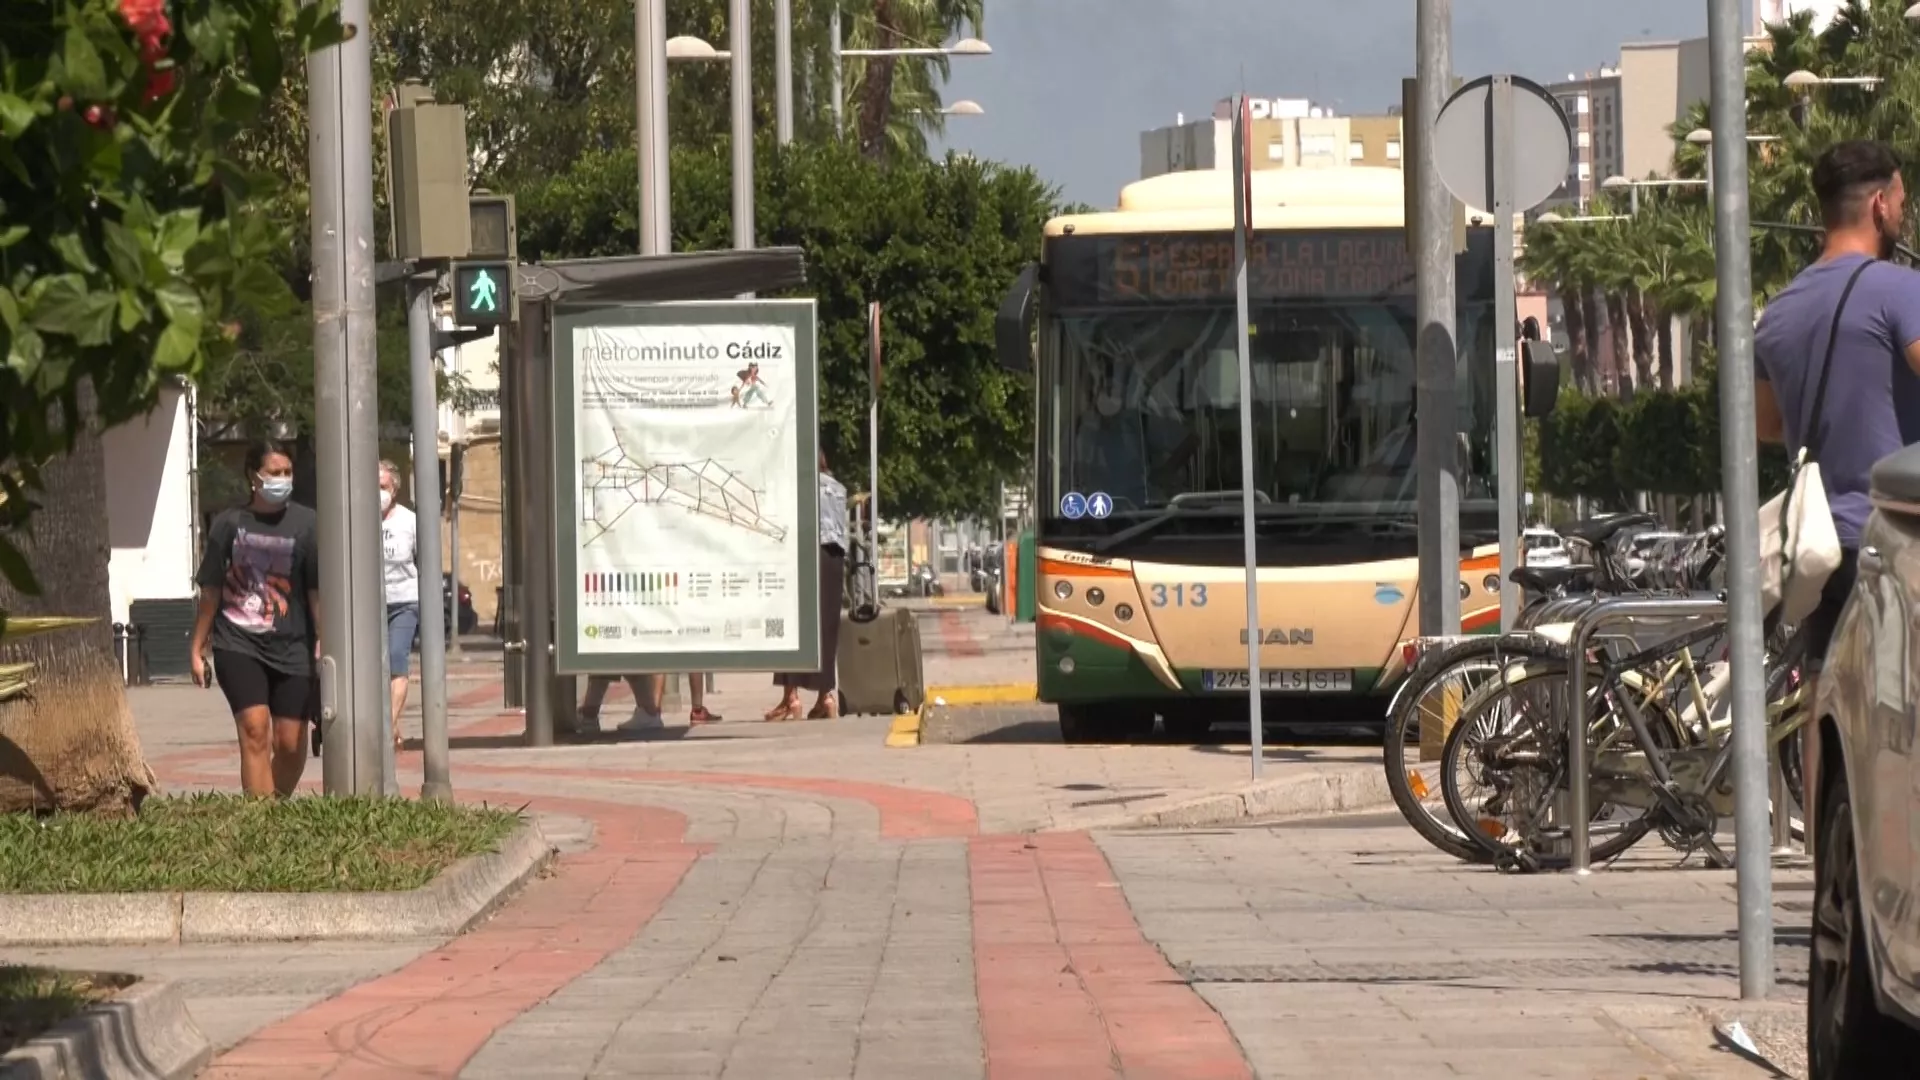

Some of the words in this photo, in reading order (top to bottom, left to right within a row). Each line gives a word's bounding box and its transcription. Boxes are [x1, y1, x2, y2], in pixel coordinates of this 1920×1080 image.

[582, 341, 719, 361] metrominuto
[726, 340, 782, 359] Cádiz
[1150, 582, 1208, 607] 313
[1268, 671, 1302, 689] FLS
